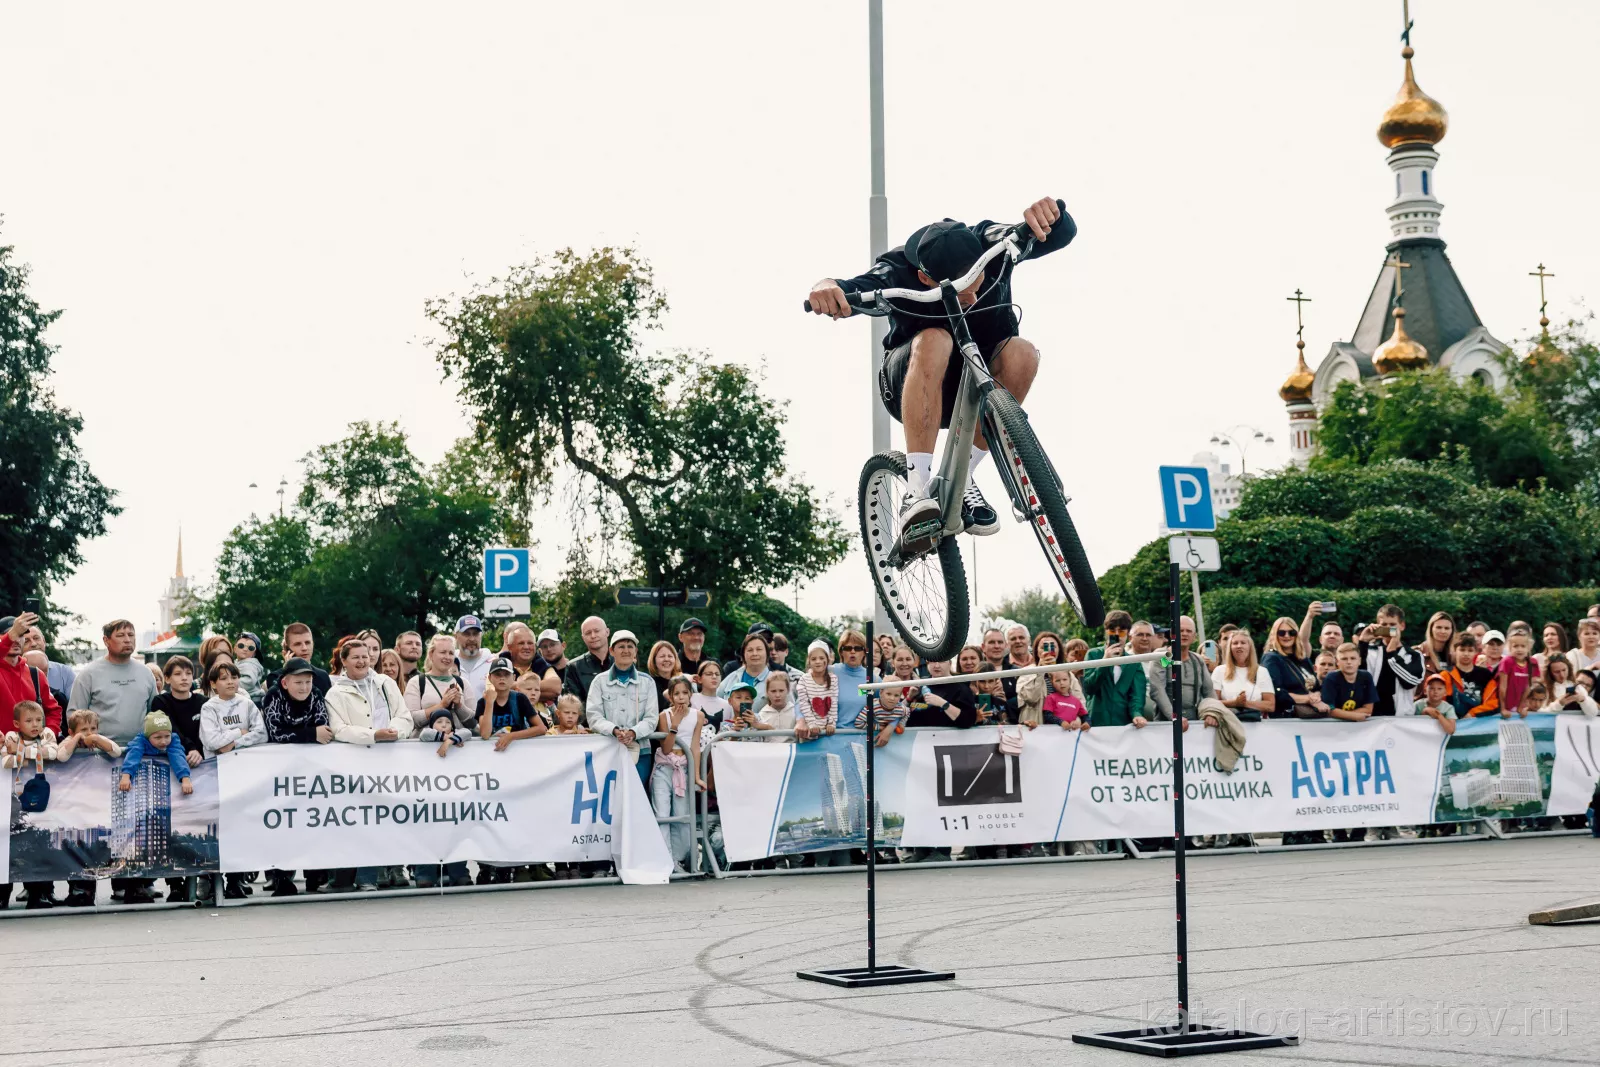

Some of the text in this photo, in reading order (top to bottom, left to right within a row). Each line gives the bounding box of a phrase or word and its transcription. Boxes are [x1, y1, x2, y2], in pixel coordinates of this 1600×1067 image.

[1173, 473, 1203, 523] P
[494, 553, 520, 590] P
[273, 772, 501, 800] НЕДВИЖИМОСТЬ
[1091, 779, 1274, 804] ОТ ЗАСТОЙЩИКА
[263, 798, 509, 830] ОТ ЗАСТРОЙЩИКА
[977, 812, 1025, 820] DOUBLE
[1295, 802, 1401, 816] ASTRA-DEVELOPMENT.RU
[940, 815, 969, 831] 1:1
[979, 822, 1017, 830] HOUSE
